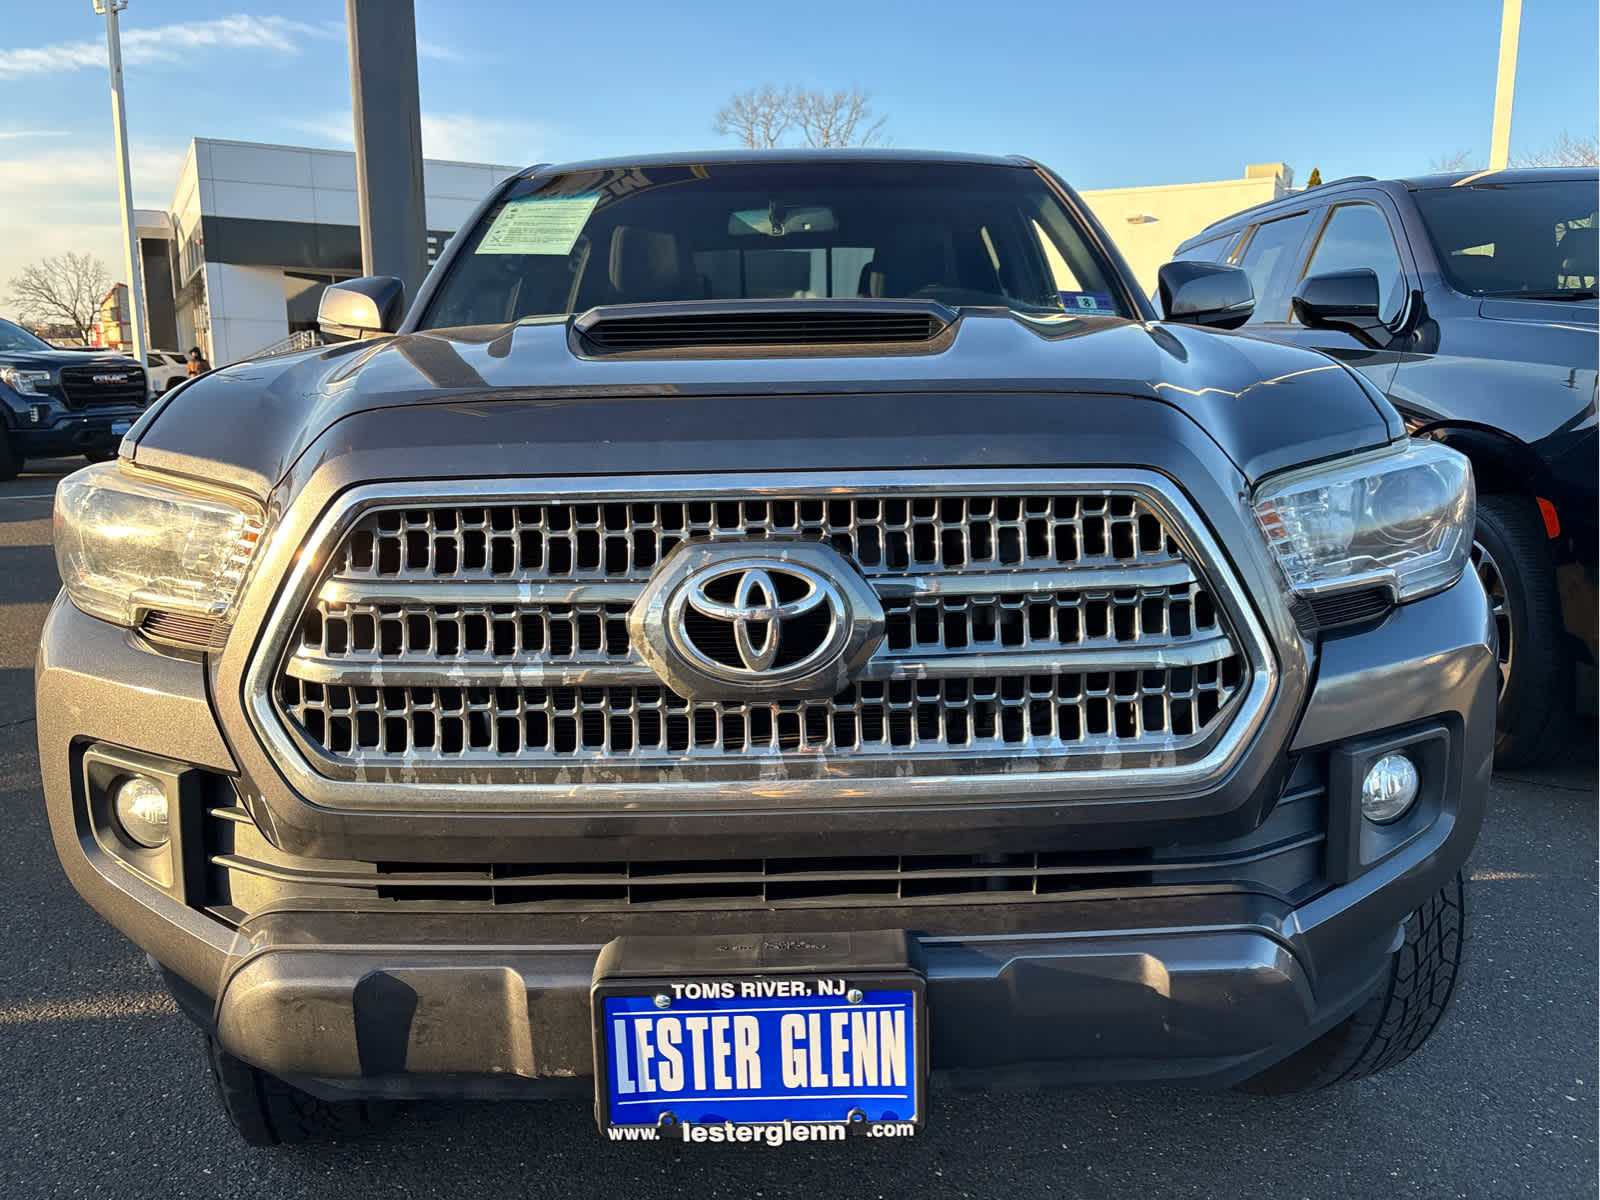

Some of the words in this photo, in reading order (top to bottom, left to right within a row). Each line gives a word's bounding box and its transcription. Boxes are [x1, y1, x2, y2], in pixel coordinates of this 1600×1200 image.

[671, 983, 735, 999] TOMS
[741, 980, 811, 998] RIVER,
[818, 979, 846, 996] NJ
[614, 1016, 761, 1093] LESTER
[781, 1010, 906, 1088] GLENN
[607, 1127, 660, 1140] www.
[682, 1120, 846, 1146] lesterglenn
[866, 1123, 914, 1137] .com
